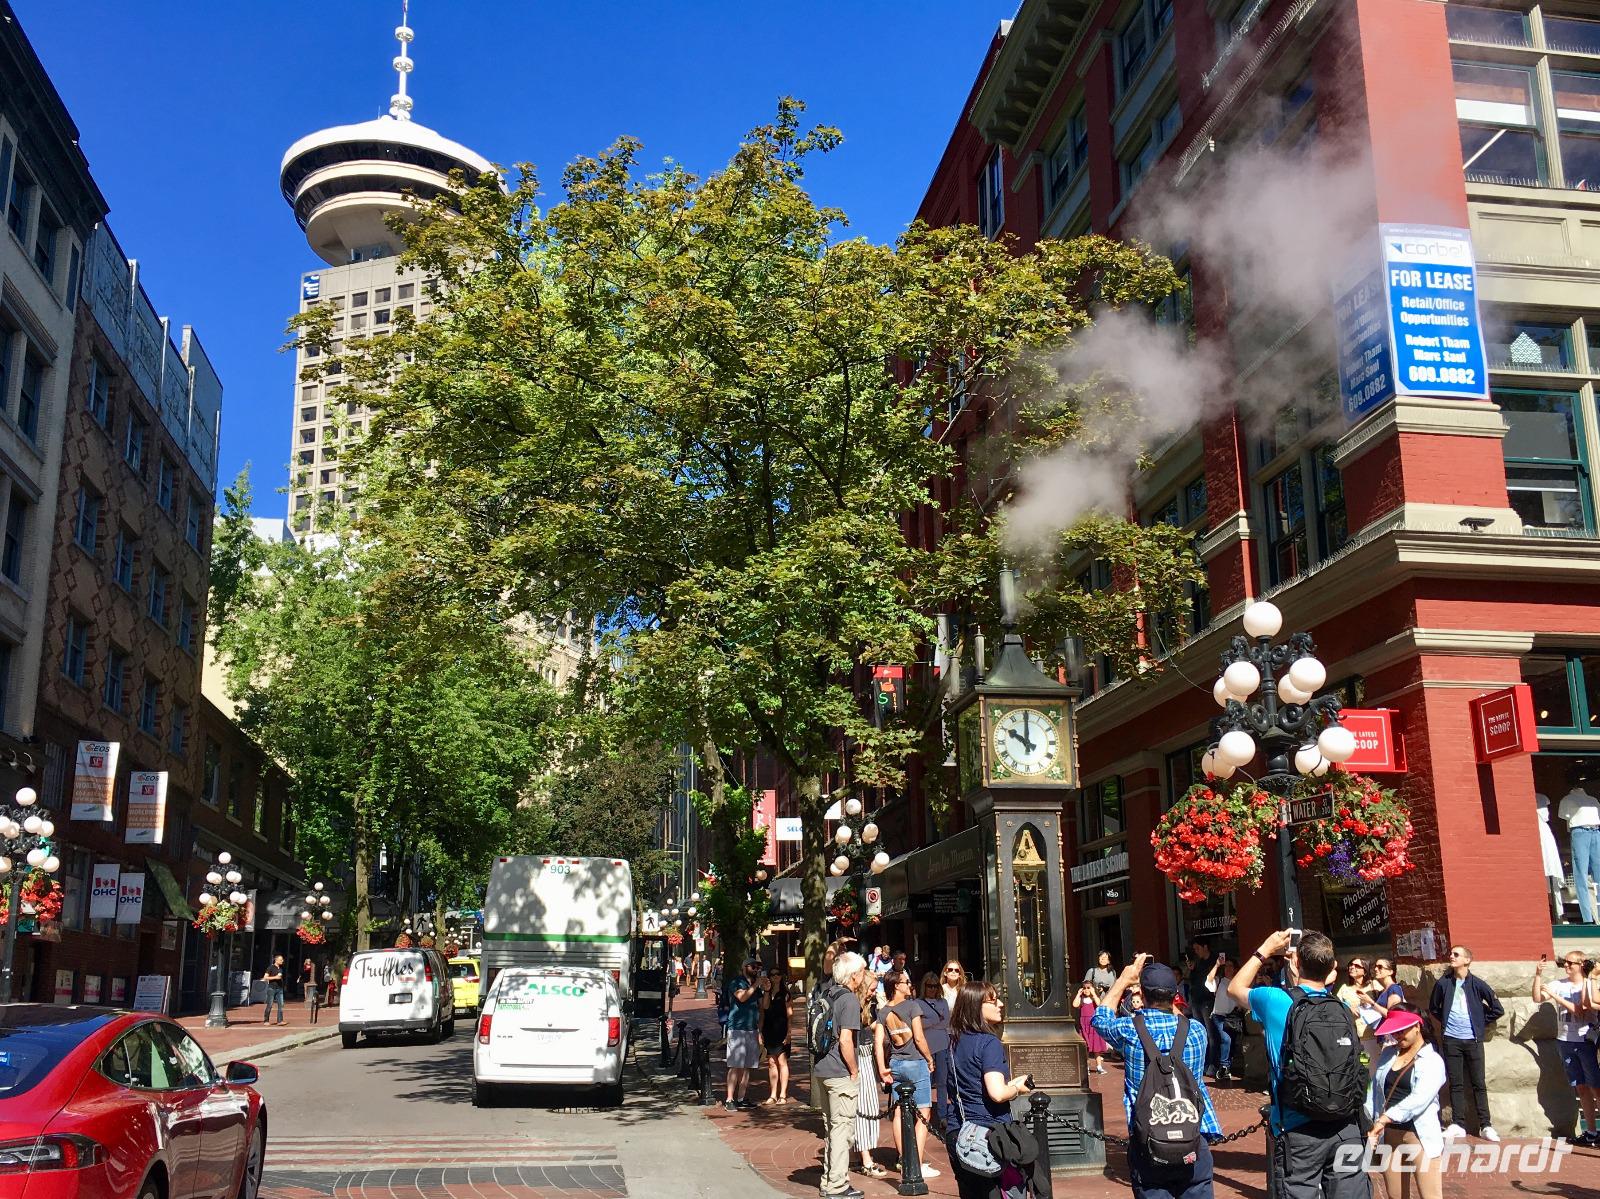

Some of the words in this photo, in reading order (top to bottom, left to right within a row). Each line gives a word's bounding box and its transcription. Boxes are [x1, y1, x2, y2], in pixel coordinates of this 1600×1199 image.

[1391, 269, 1422, 288] FOR
[1425, 271, 1473, 291] LEASE
[1401, 296, 1465, 311] Retail/Office
[1400, 311, 1469, 327] Opportunities
[1404, 334, 1440, 348] Robert
[1442, 336, 1470, 349] Tham
[1413, 349, 1441, 362] Marc
[1408, 366, 1476, 385] 609.0882
[1348, 373, 1387, 413] 609.0882
[1489, 720, 1511, 736] SCOOP
[1354, 739, 1379, 750] COOP
[1292, 800, 1317, 820] WATER
[550, 865, 571, 875] 903
[1082, 858, 1105, 881] LATEST
[1105, 852, 1129, 874] SCOOP
[93, 888, 117, 896] OHC
[120, 896, 142, 904] OHC
[1342, 915, 1355, 929] the
[1356, 897, 1379, 920] steam
[1361, 914, 1381, 935] since
[355, 957, 415, 987] Truffles
